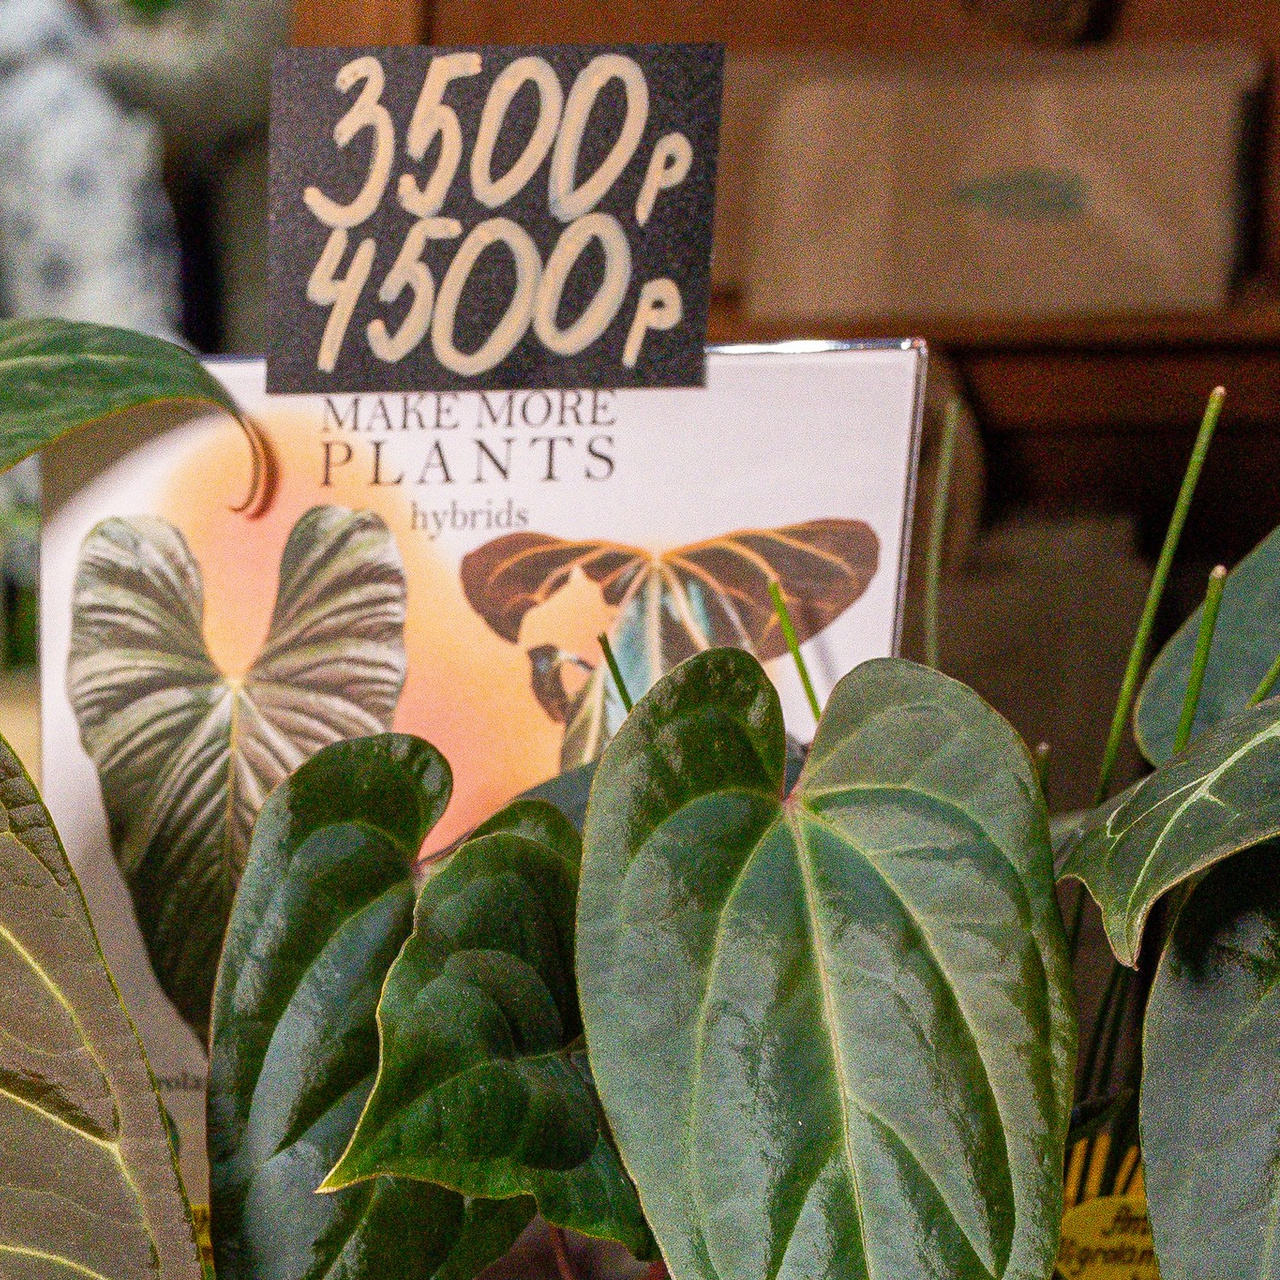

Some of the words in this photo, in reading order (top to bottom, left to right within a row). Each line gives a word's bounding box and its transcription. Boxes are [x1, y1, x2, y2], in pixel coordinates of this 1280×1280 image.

[321, 394, 461, 433] MAKE
[475, 391, 619, 430] MORE
[320, 434, 618, 488] PLANTS
[409, 498, 530, 540] hybrids
